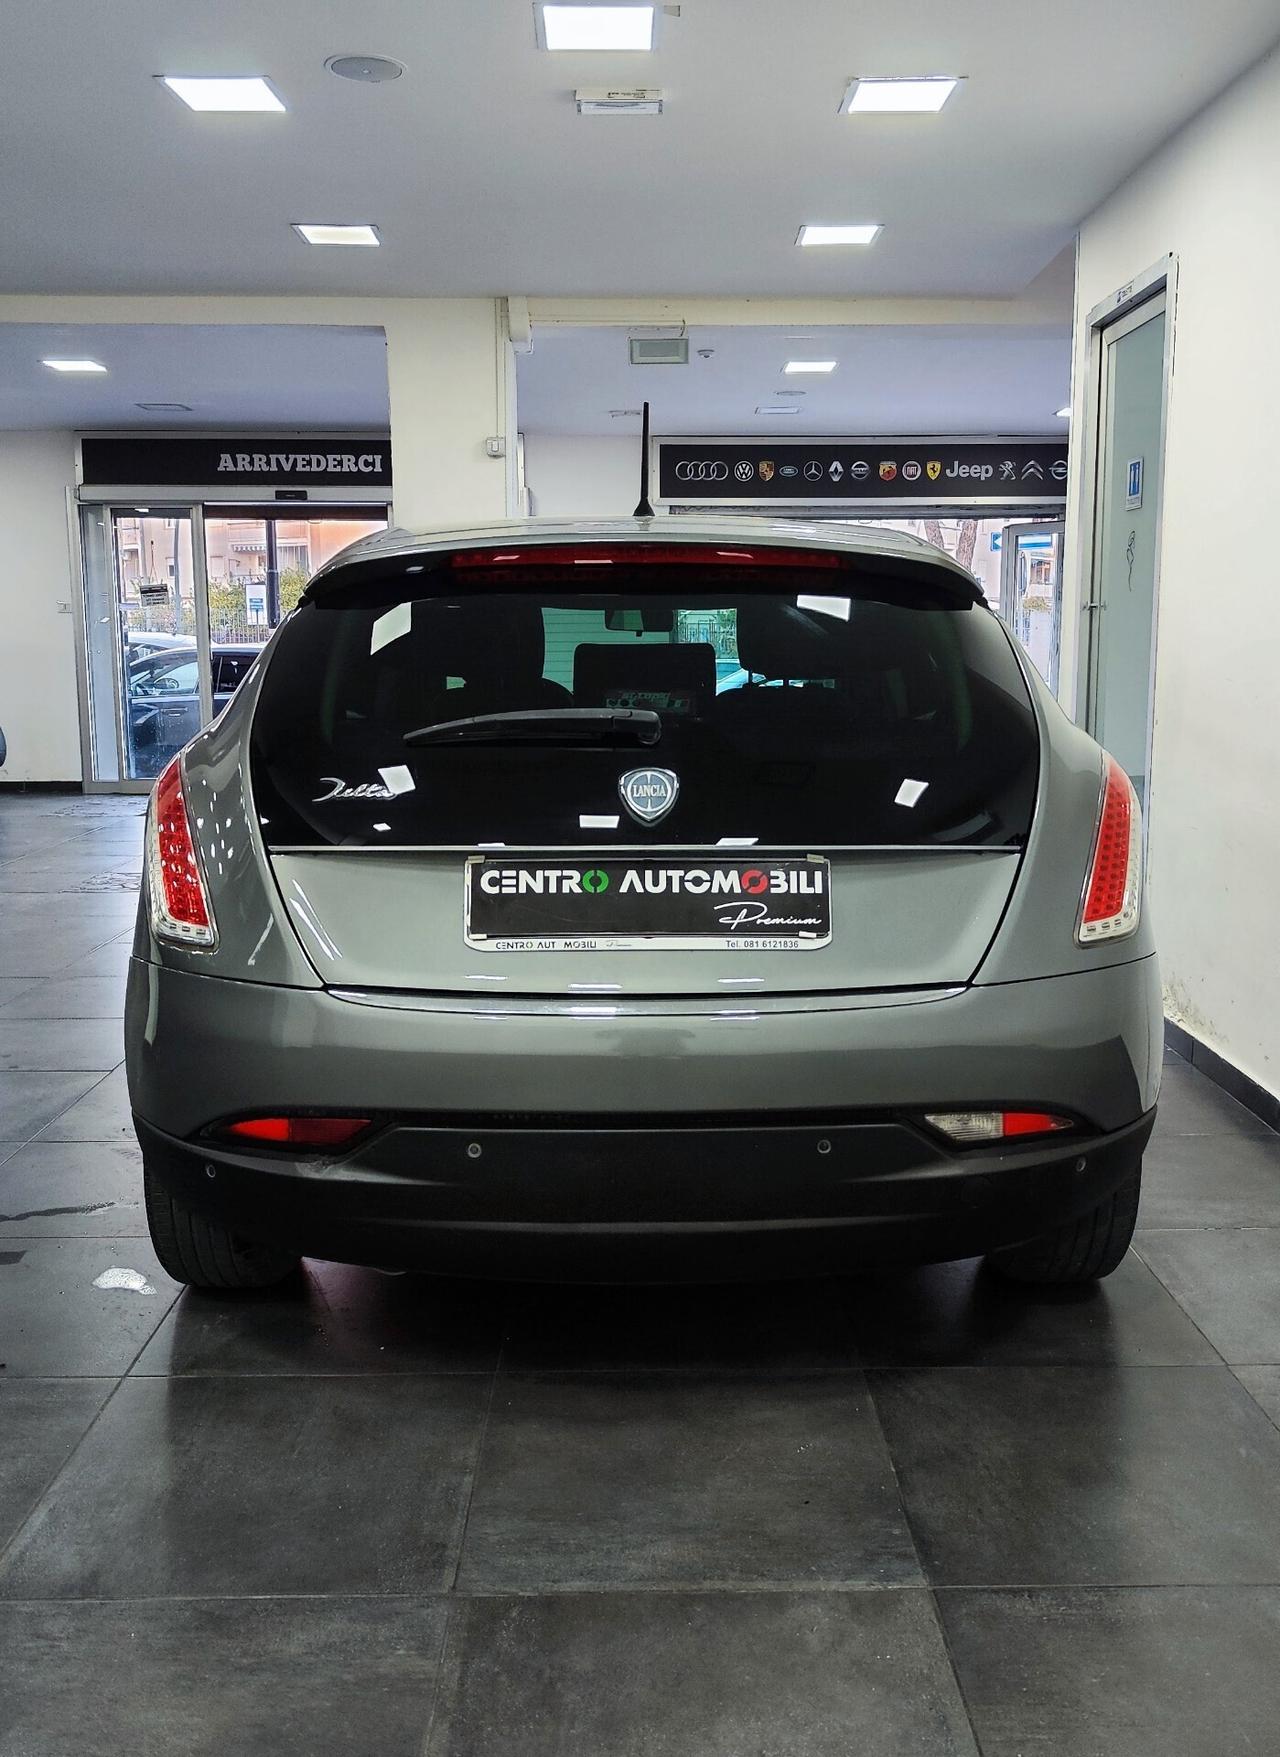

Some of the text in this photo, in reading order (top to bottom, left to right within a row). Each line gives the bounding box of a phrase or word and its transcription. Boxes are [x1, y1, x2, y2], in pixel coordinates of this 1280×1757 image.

[217, 453, 383, 473] ARRIVEDERCI
[945, 460, 994, 481] Jeep
[632, 784, 667, 797] LANCIA
[480, 869, 823, 895] CENTRO AUTOMOBILI
[713, 901, 823, 931] Premium
[495, 940, 534, 950] CENTRO
[726, 940, 799, 948] Tel. 081 6121836
